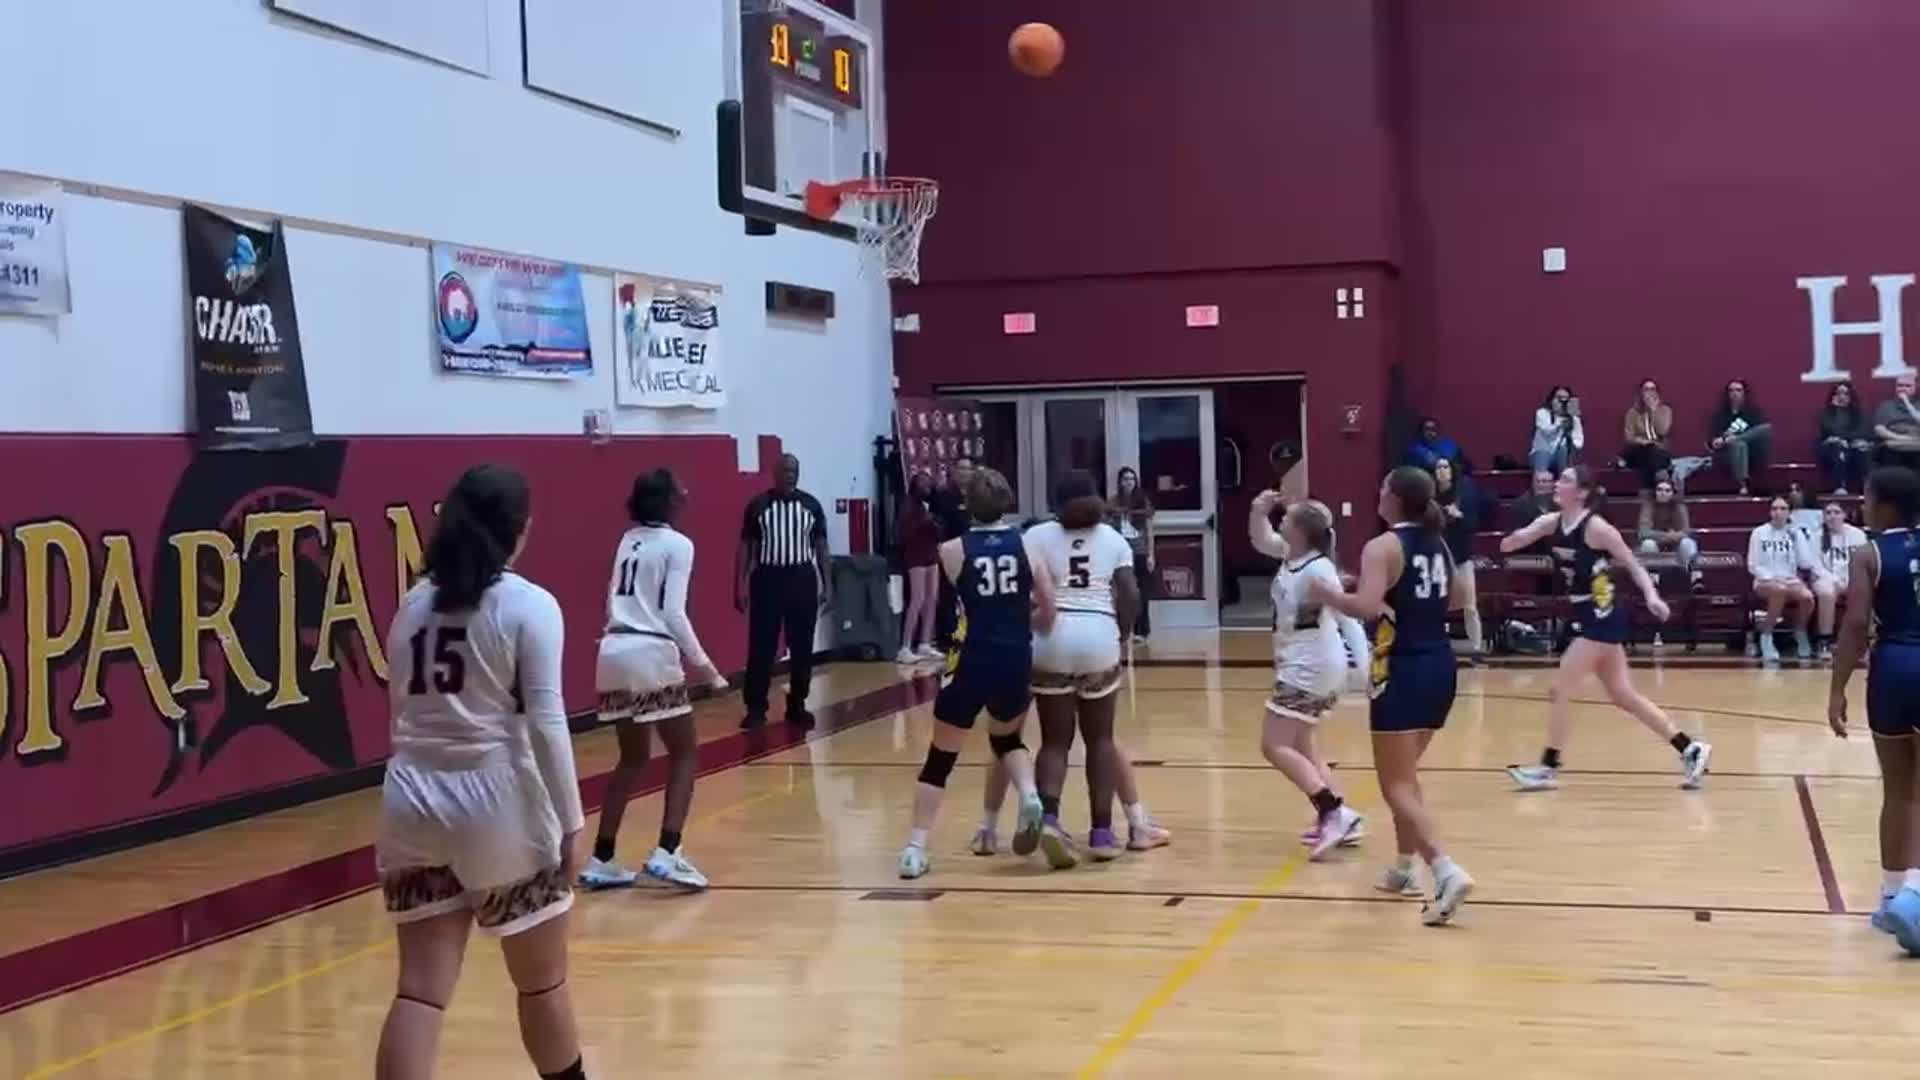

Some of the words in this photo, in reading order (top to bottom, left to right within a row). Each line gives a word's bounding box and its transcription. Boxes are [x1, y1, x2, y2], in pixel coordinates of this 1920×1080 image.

[1796, 273, 1917, 382] H
[616, 557, 639, 596] 11
[973, 554, 1019, 597] 32
[1068, 554, 1090, 589] 5
[1412, 553, 1449, 599] 34
[0, 503, 441, 754] PARTA
[407, 626, 468, 696] 15
